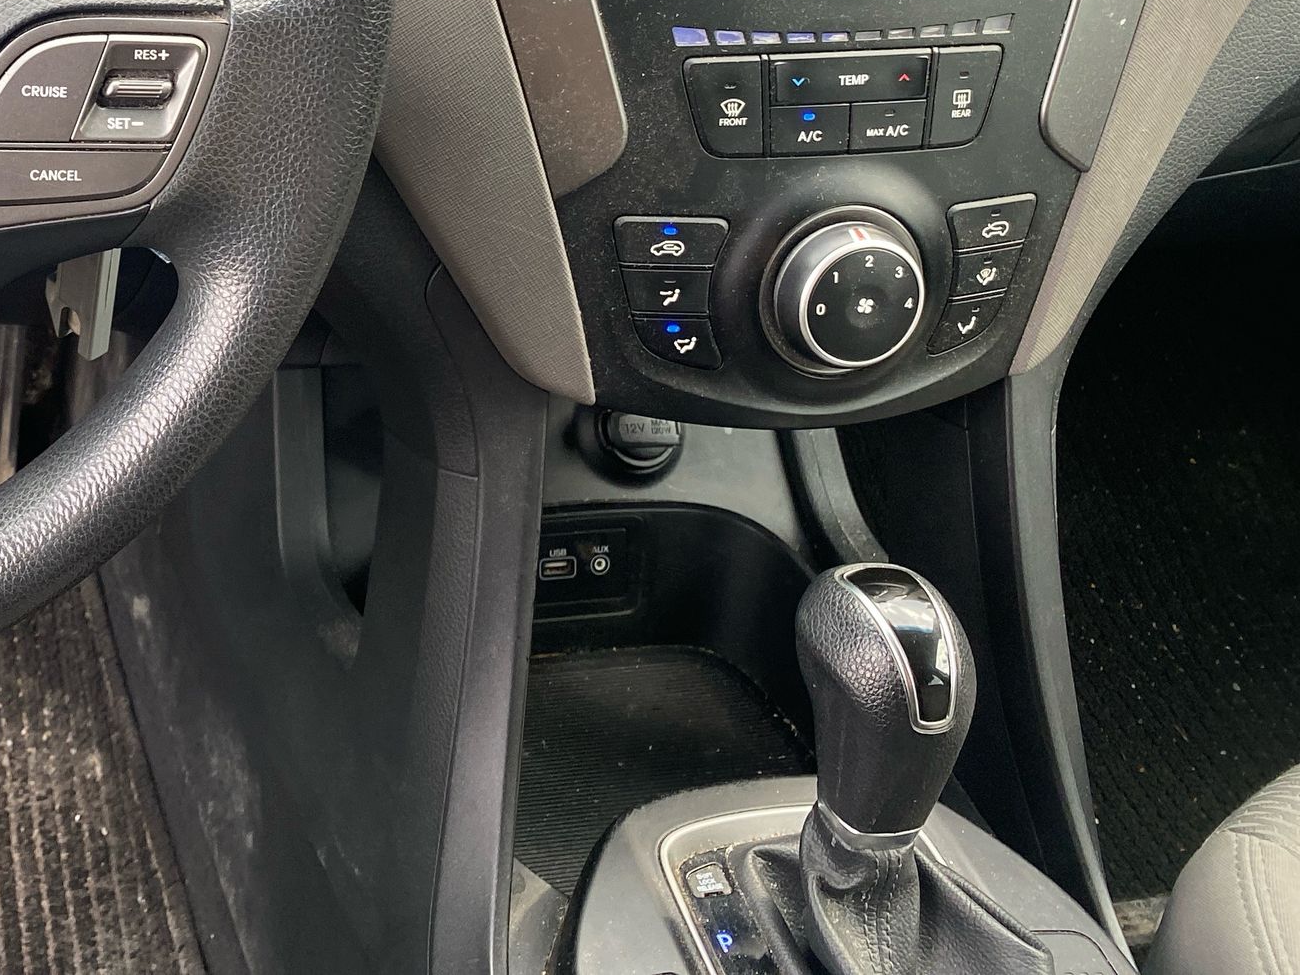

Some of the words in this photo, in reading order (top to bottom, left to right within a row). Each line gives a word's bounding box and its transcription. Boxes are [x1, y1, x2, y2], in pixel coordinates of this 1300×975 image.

[838, 74, 869, 86] TEMP
[21, 85, 67, 98] CRUISE
[951, 109, 972, 119] REAR
[718, 117, 748, 127] FRONT
[797, 129, 823, 143] A/C
[866, 128, 884, 137] MAX
[885, 124, 910, 138] A/C
[29, 169, 82, 182] CANCEL
[865, 255, 874, 267] 2
[832, 271, 839, 284] 1
[894, 266, 904, 279] 3
[903, 297, 913, 309] 4
[815, 303, 826, 316] 0
[625, 423, 645, 434] 12V
[549, 548, 567, 557] USB
[592, 545, 609, 553] AUX
[716, 933, 733, 953] P
